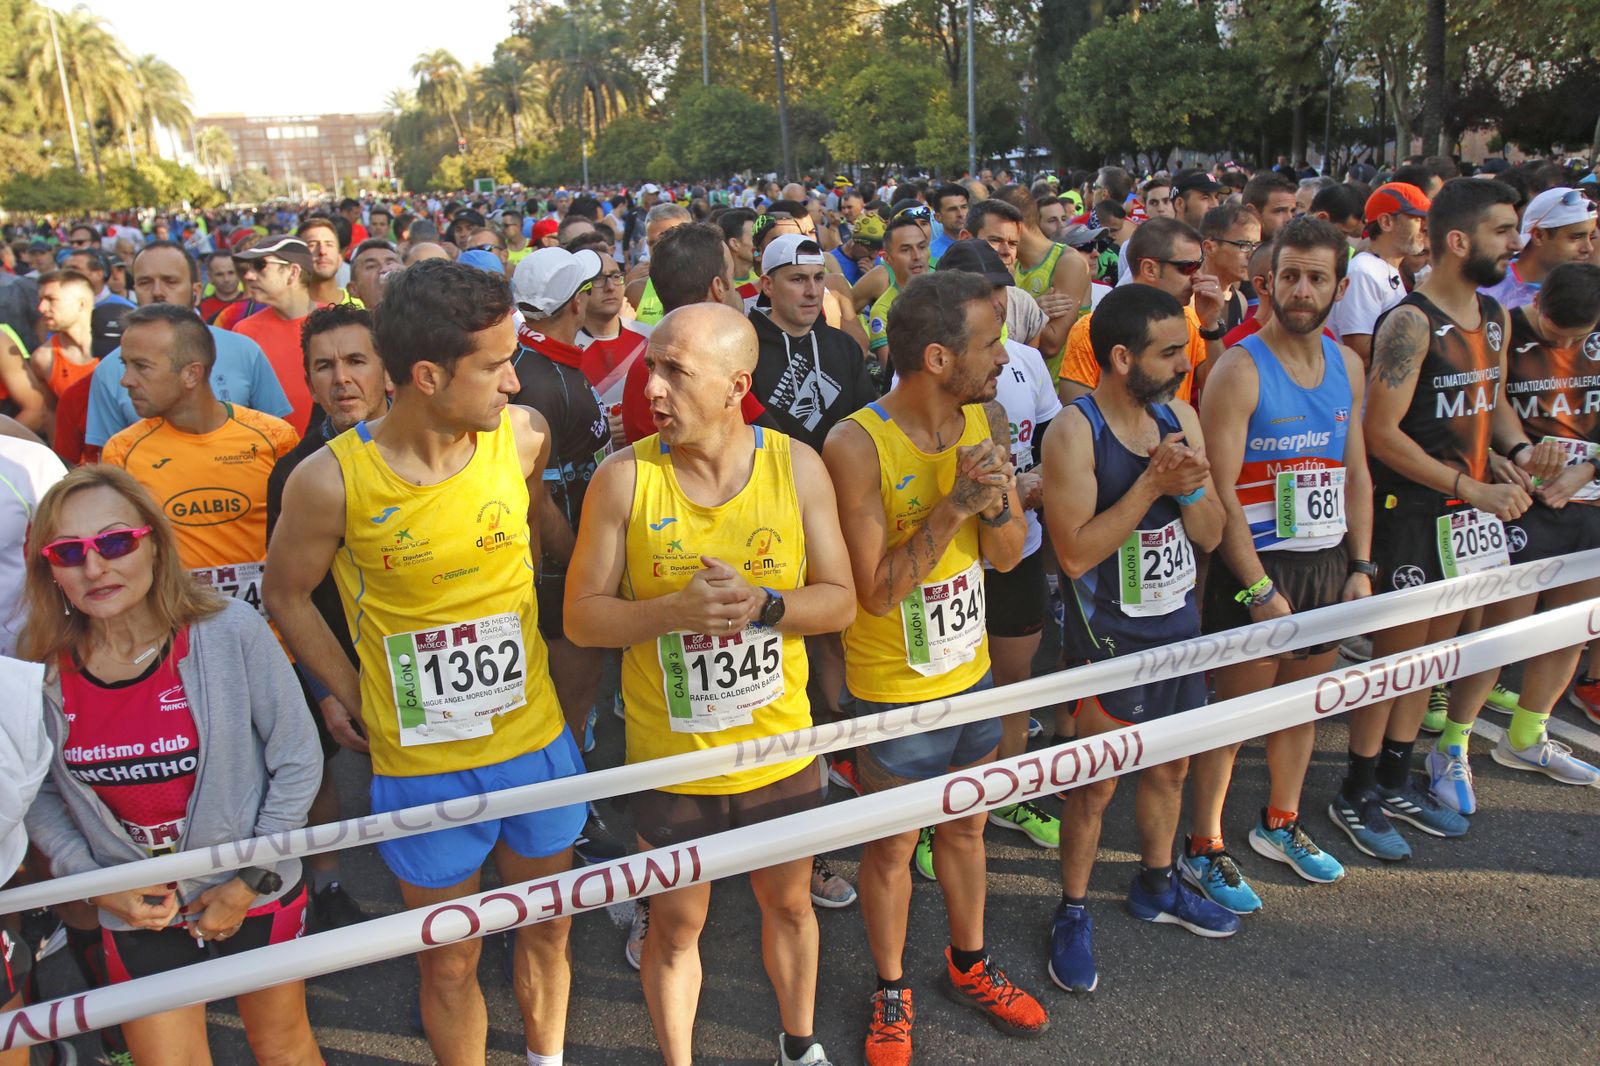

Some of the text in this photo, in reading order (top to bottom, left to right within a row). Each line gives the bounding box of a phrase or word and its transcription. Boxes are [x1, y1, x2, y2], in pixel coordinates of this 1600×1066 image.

[1433, 369, 1481, 388] CLIMATIZACIÓN
[1507, 377, 1562, 394] CLIMATIZACIÓN
[1562, 379, 1568, 389] Y
[1249, 430, 1332, 452] enerplus
[172, 498, 241, 517] GALBIS
[1307, 487, 1339, 520] 681
[1453, 522, 1503, 559] 2058
[491, 615, 519, 626] MEDIA
[910, 612, 924, 647] CAJÓN
[417, 640, 447, 650] IMDECO
[685, 642, 713, 650] IMDECO
[424, 639, 522, 696] 1362
[691, 637, 780, 691] 1345
[1314, 642, 1461, 714] IMDECO
[401, 663, 417, 708] CAJÓN
[670, 662, 684, 698] CAJÓN
[689, 693, 719, 702] RAFAEL
[720, 682, 761, 699] CALDERÓN
[444, 696, 466, 705] ANGEL
[466, 689, 493, 700] MORENO
[64, 734, 190, 763] atletismo club
[942, 730, 1144, 816] IMDECO
[421, 845, 701, 946] IMDECO
